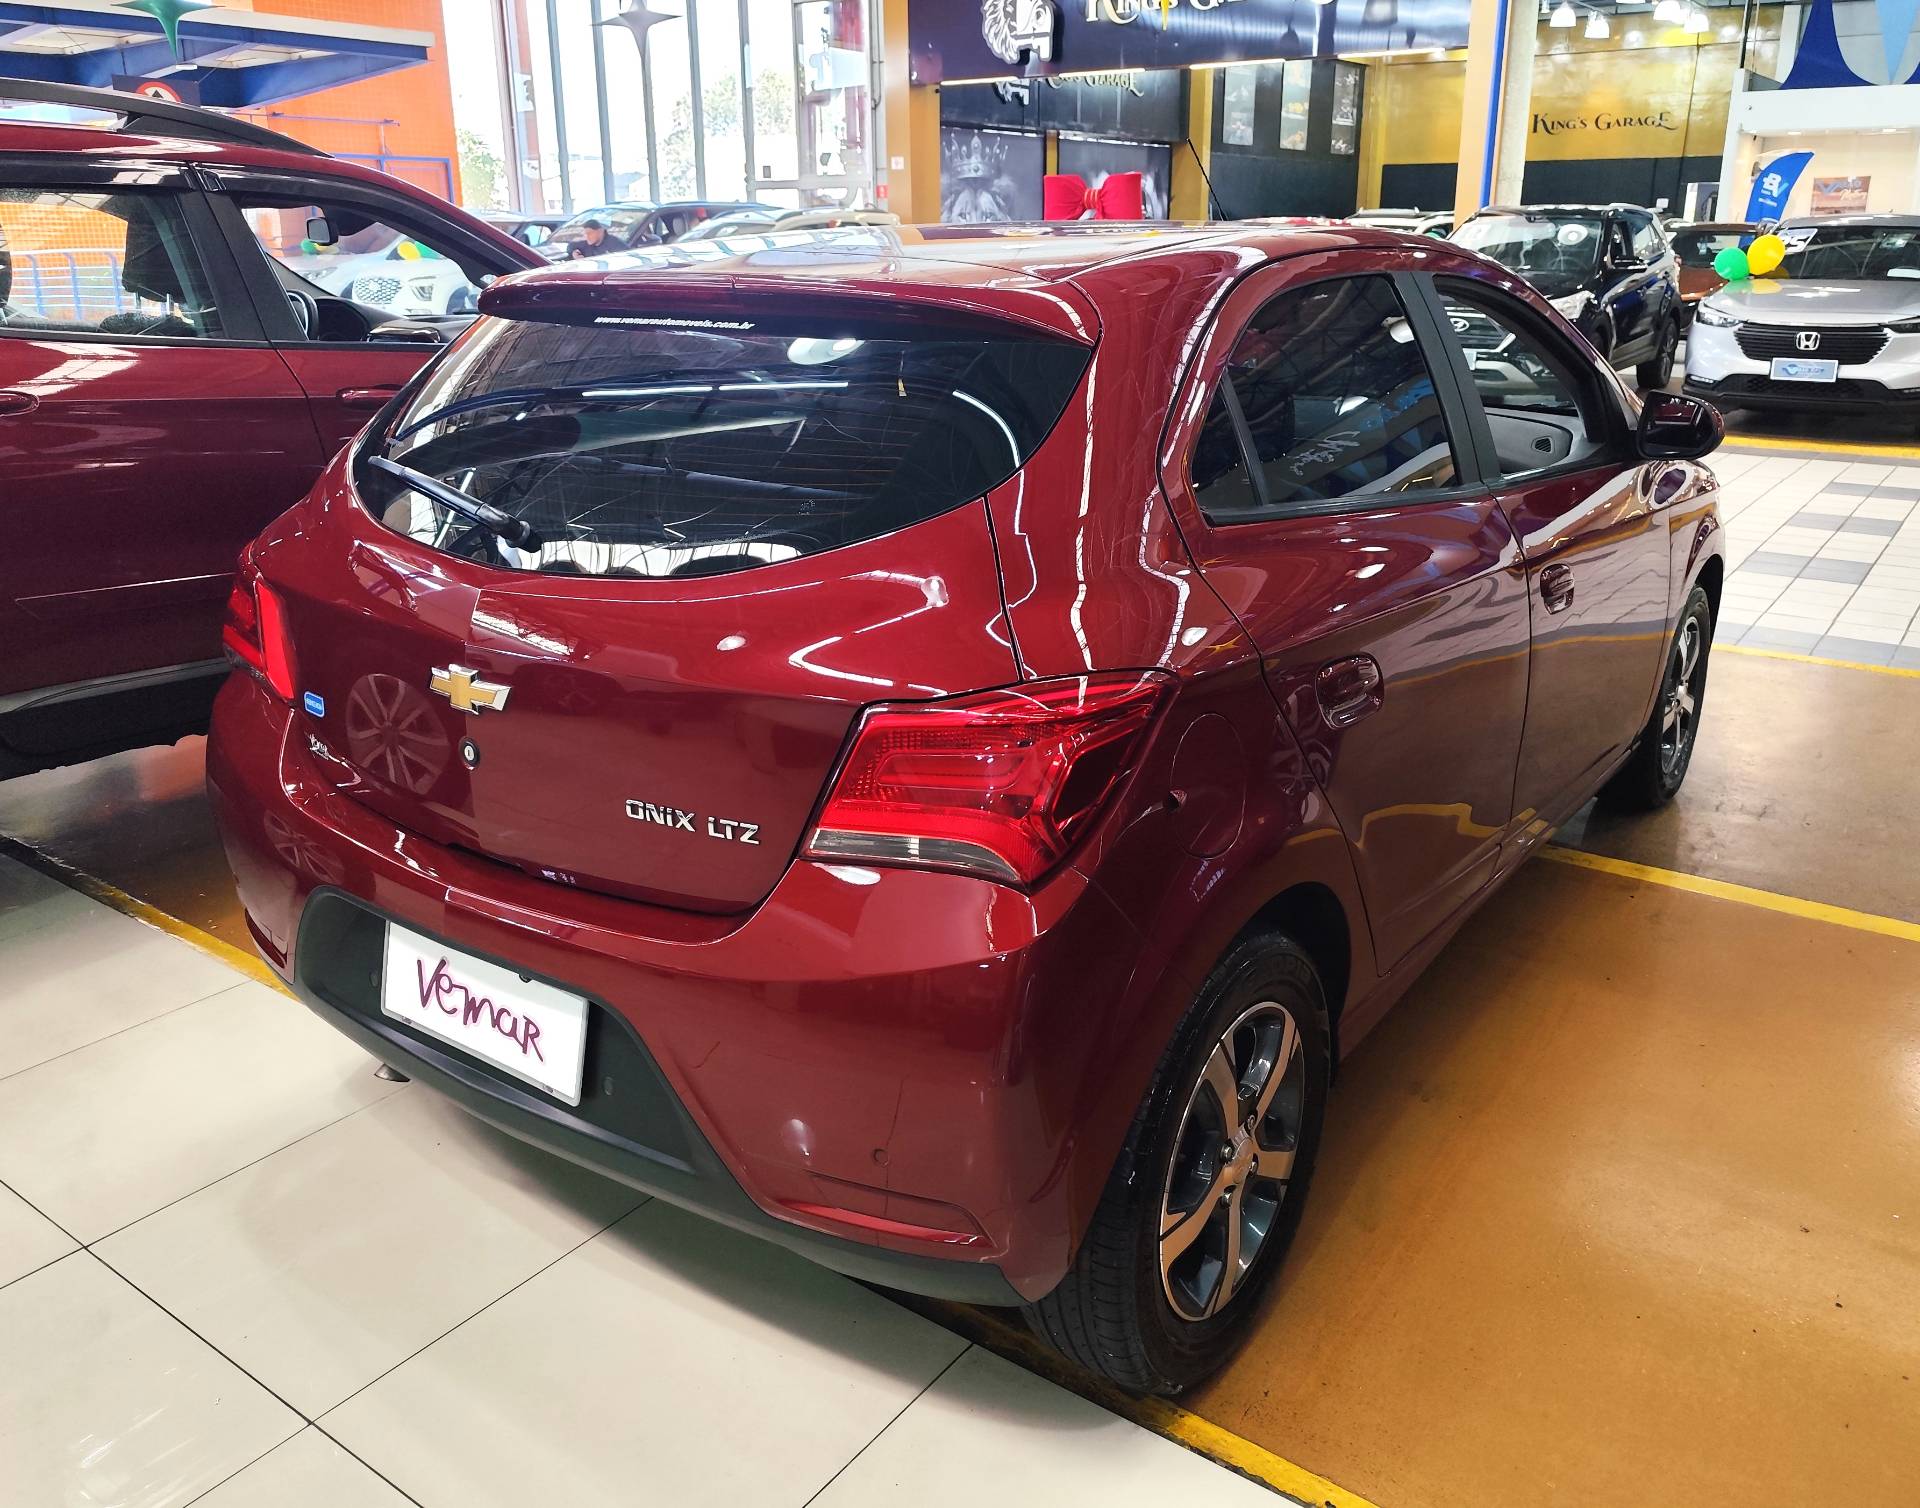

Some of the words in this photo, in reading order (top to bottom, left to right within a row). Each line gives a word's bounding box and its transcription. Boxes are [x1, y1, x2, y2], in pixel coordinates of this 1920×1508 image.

[1532, 112, 1588, 136] KING'S
[1594, 111, 1680, 131] GARAGE
[707, 816, 760, 845] LTZ
